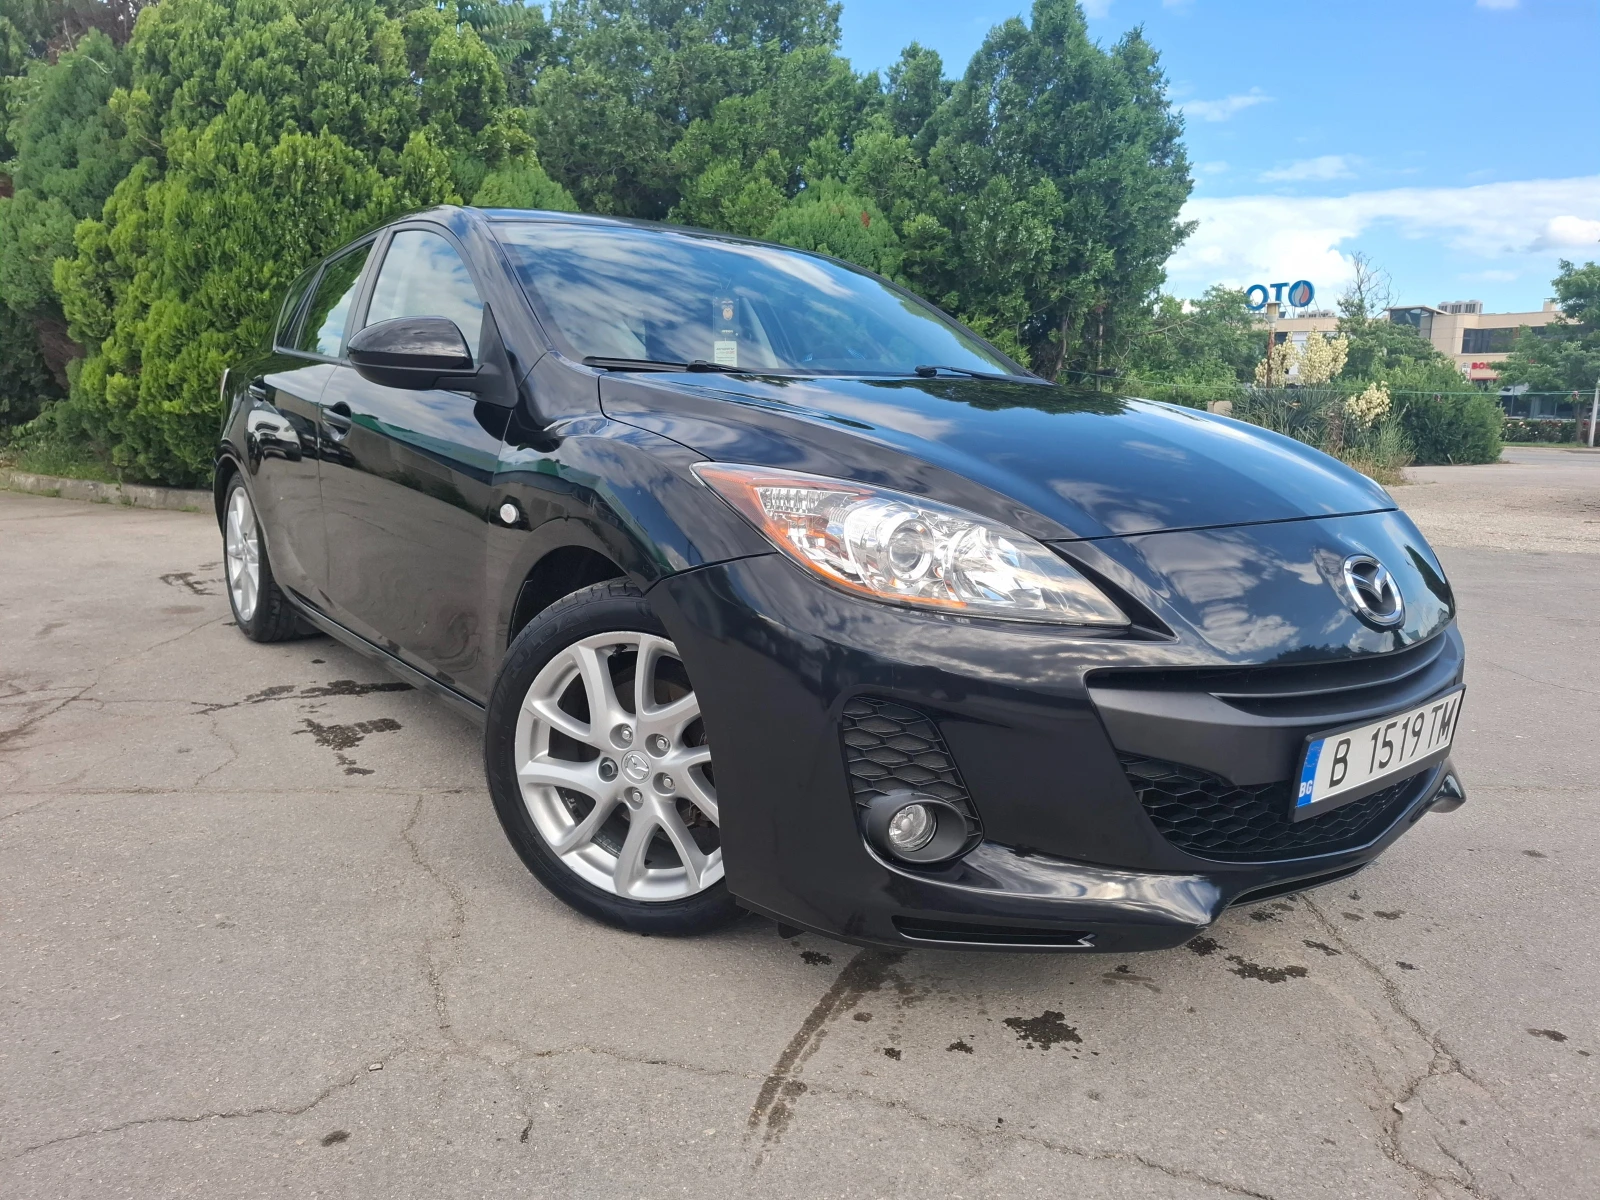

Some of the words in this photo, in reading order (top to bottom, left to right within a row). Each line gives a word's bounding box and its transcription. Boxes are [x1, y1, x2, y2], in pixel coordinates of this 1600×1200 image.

[1328, 737, 1352, 788] B
[1369, 712, 1424, 774] 1519
[1427, 698, 1457, 749] TM
[1298, 780, 1314, 798] BG
